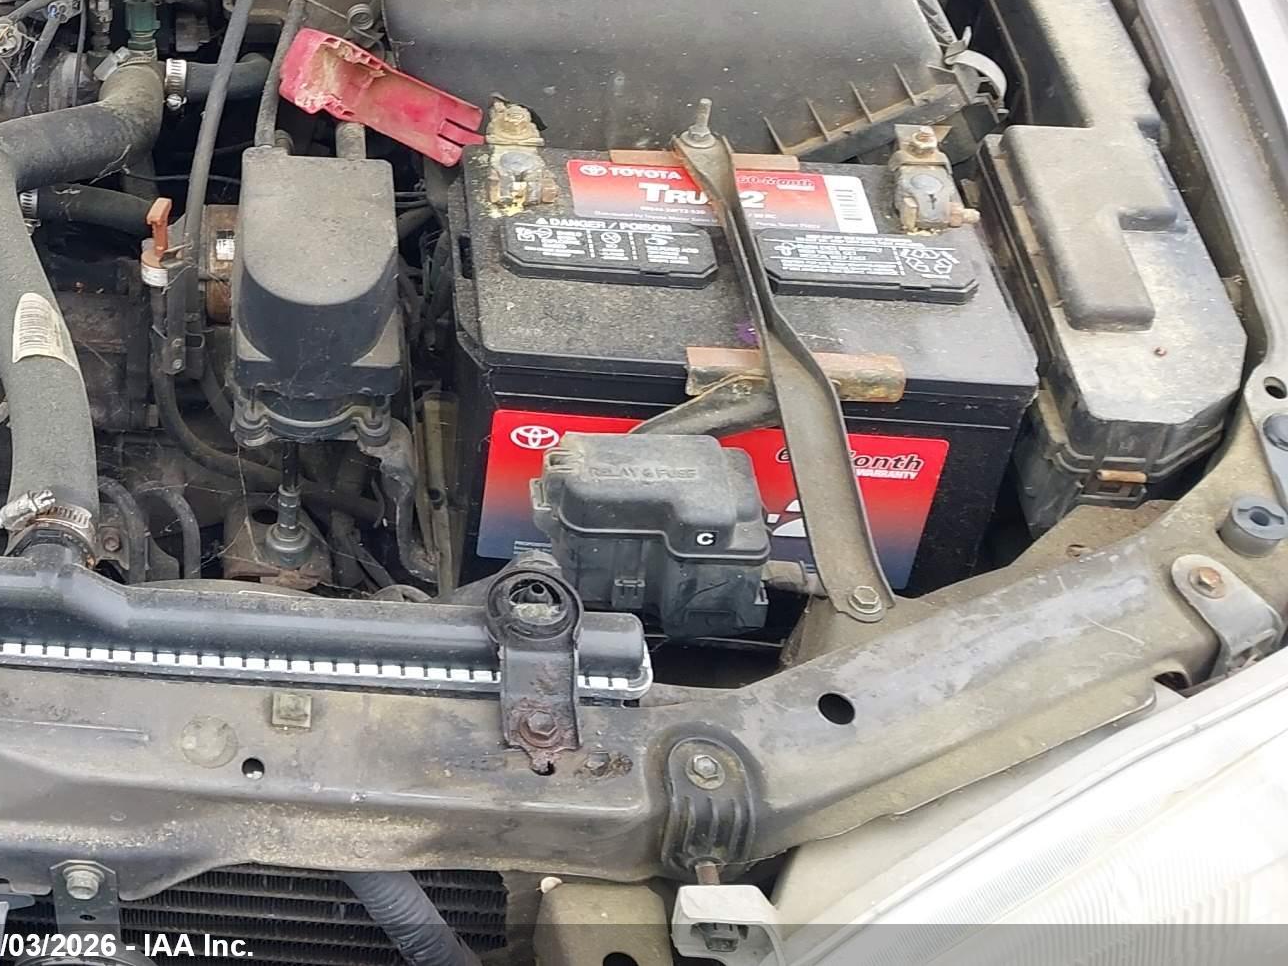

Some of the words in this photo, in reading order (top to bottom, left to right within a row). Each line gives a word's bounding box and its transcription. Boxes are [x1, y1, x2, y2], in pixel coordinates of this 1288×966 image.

[607, 166, 682, 180] TOYOTA
[548, 217, 607, 230] DANGER
[619, 221, 673, 233] POISON
[696, 532, 715, 546] C
